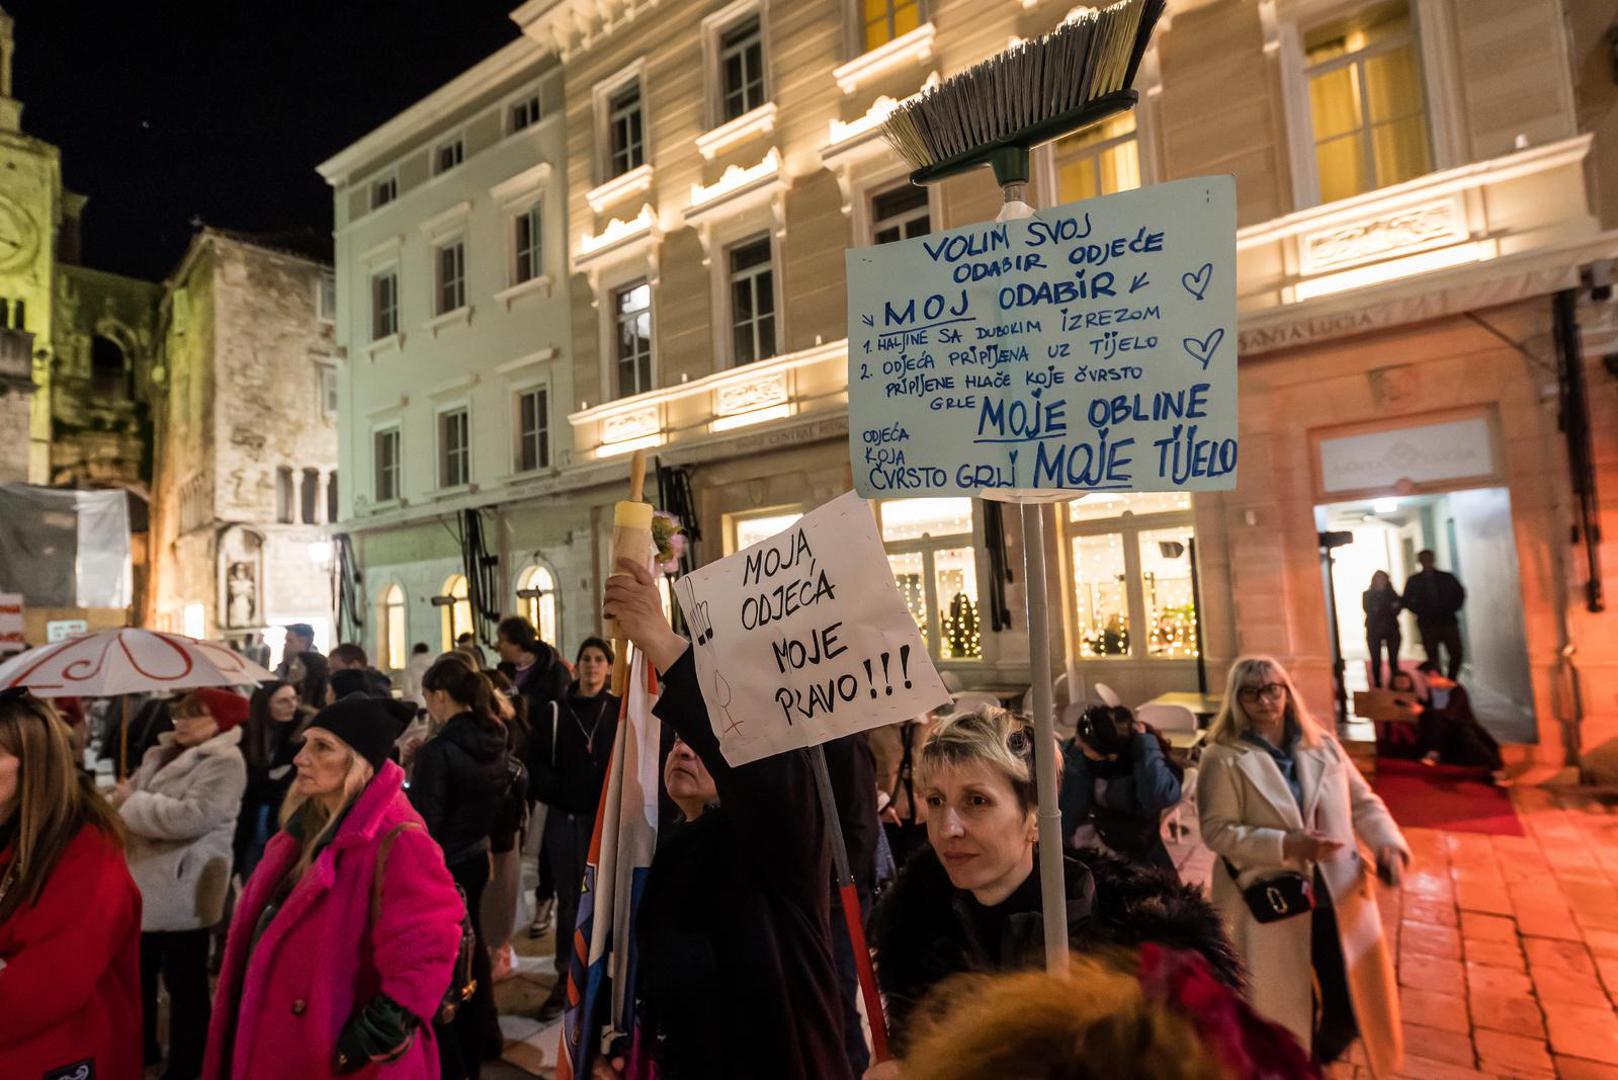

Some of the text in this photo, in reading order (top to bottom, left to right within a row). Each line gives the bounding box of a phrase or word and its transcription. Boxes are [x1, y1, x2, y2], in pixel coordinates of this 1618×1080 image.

[923, 213, 1092, 262] VOLIM SVOJ
[953, 226, 1165, 283] ODABIR ODJEĆE
[884, 269, 1117, 326] MOJ ODABIR
[860, 363, 873, 380] 2.
[882, 350, 936, 379] ODJEĆA
[1048, 343, 1071, 359] UZ
[1089, 331, 1159, 360] TIJELO
[863, 305, 1161, 354] 1. HALJINE SA DUBOKIM IZREZOM
[965, 371, 1012, 389] HLAČE
[1025, 365, 1065, 389] KOJE
[1074, 365, 1143, 384] ČVRSTO
[863, 421, 911, 446] ODJEĆA
[930, 383, 1211, 439] GRLE MOJE OBLINE
[864, 447, 906, 466] KOJA
[869, 424, 1238, 490] ČVRSTO GRLI MOJE TIJELO
[743, 528, 812, 587] MOJA
[741, 558, 836, 630] ODJEĆA
[771, 621, 849, 674] MOJE
